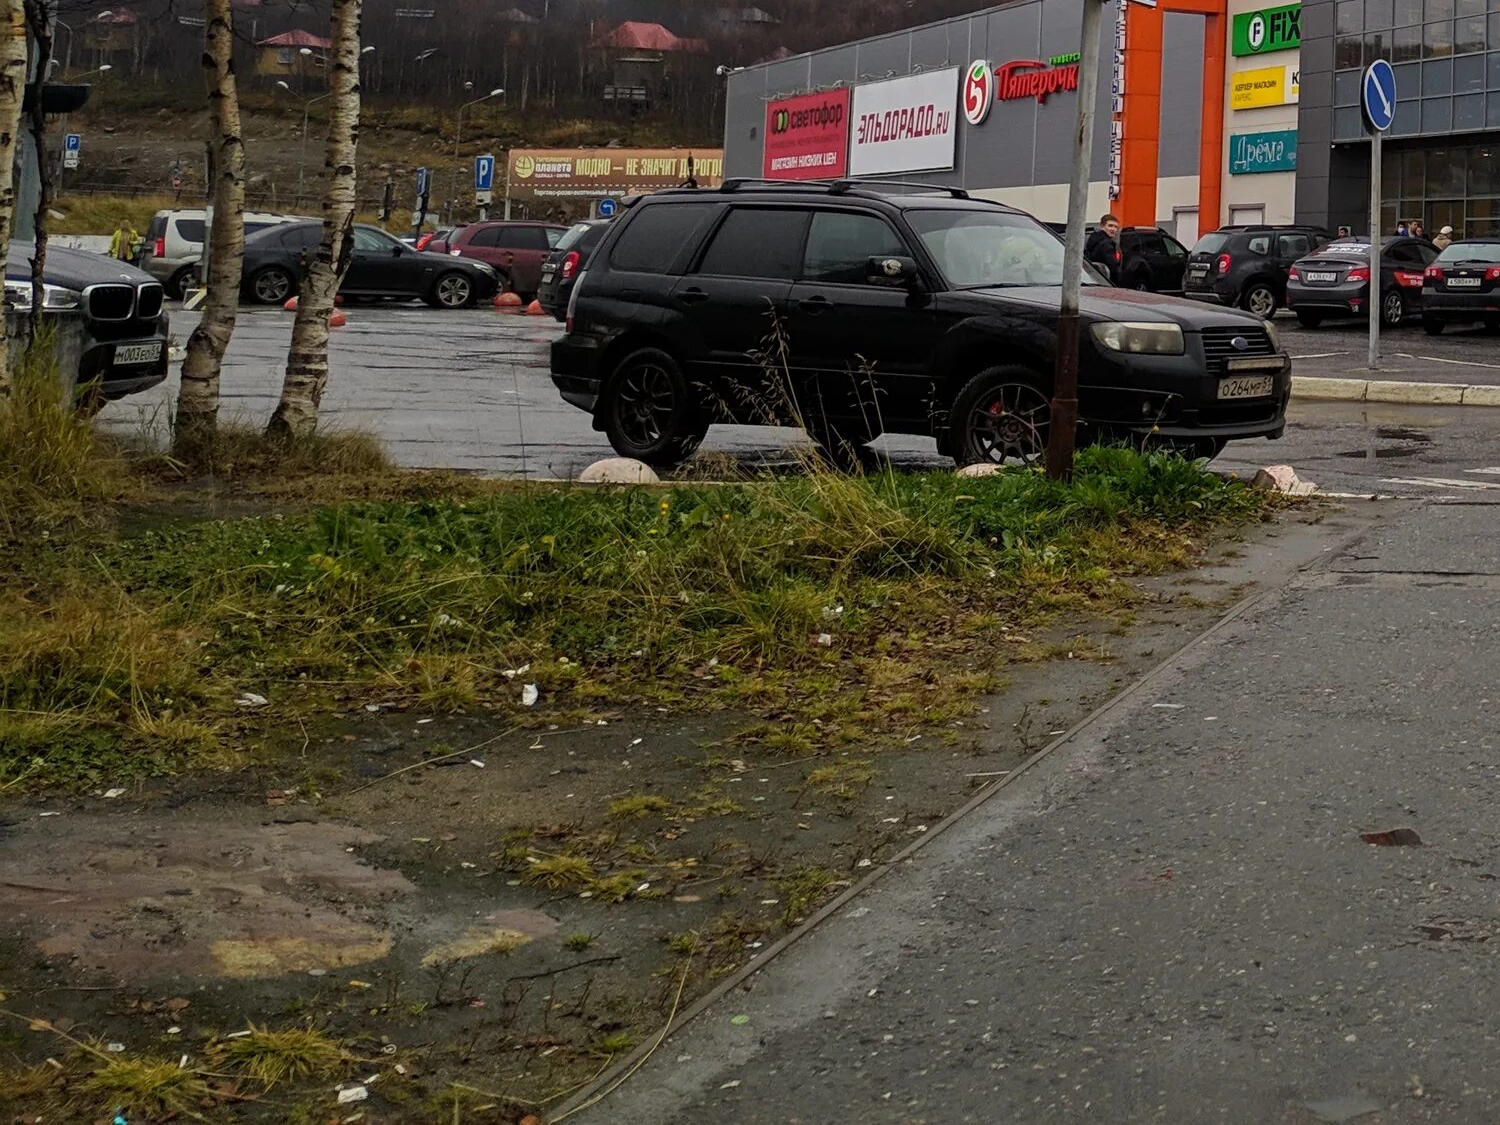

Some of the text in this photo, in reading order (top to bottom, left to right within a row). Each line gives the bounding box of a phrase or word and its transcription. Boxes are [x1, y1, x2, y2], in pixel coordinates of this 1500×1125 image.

[994, 59, 1080, 104] Пятерочк
[791, 101, 842, 130] светофор
[70, 137, 76, 147] P
[1234, 136, 1284, 172] Дрёма
[480, 160, 488, 185] P
[576, 158, 611, 177] МОДНО
[626, 159, 640, 176] НЕ
[642, 158, 677, 176] ЗНАЧИТ
[679, 158, 723, 179] ДРОГО!
[771, 152, 837, 170] МАГАЗИН НИЗКИХ ЦЕН
[1108, 121, 1122, 200] ЦЕНТР
